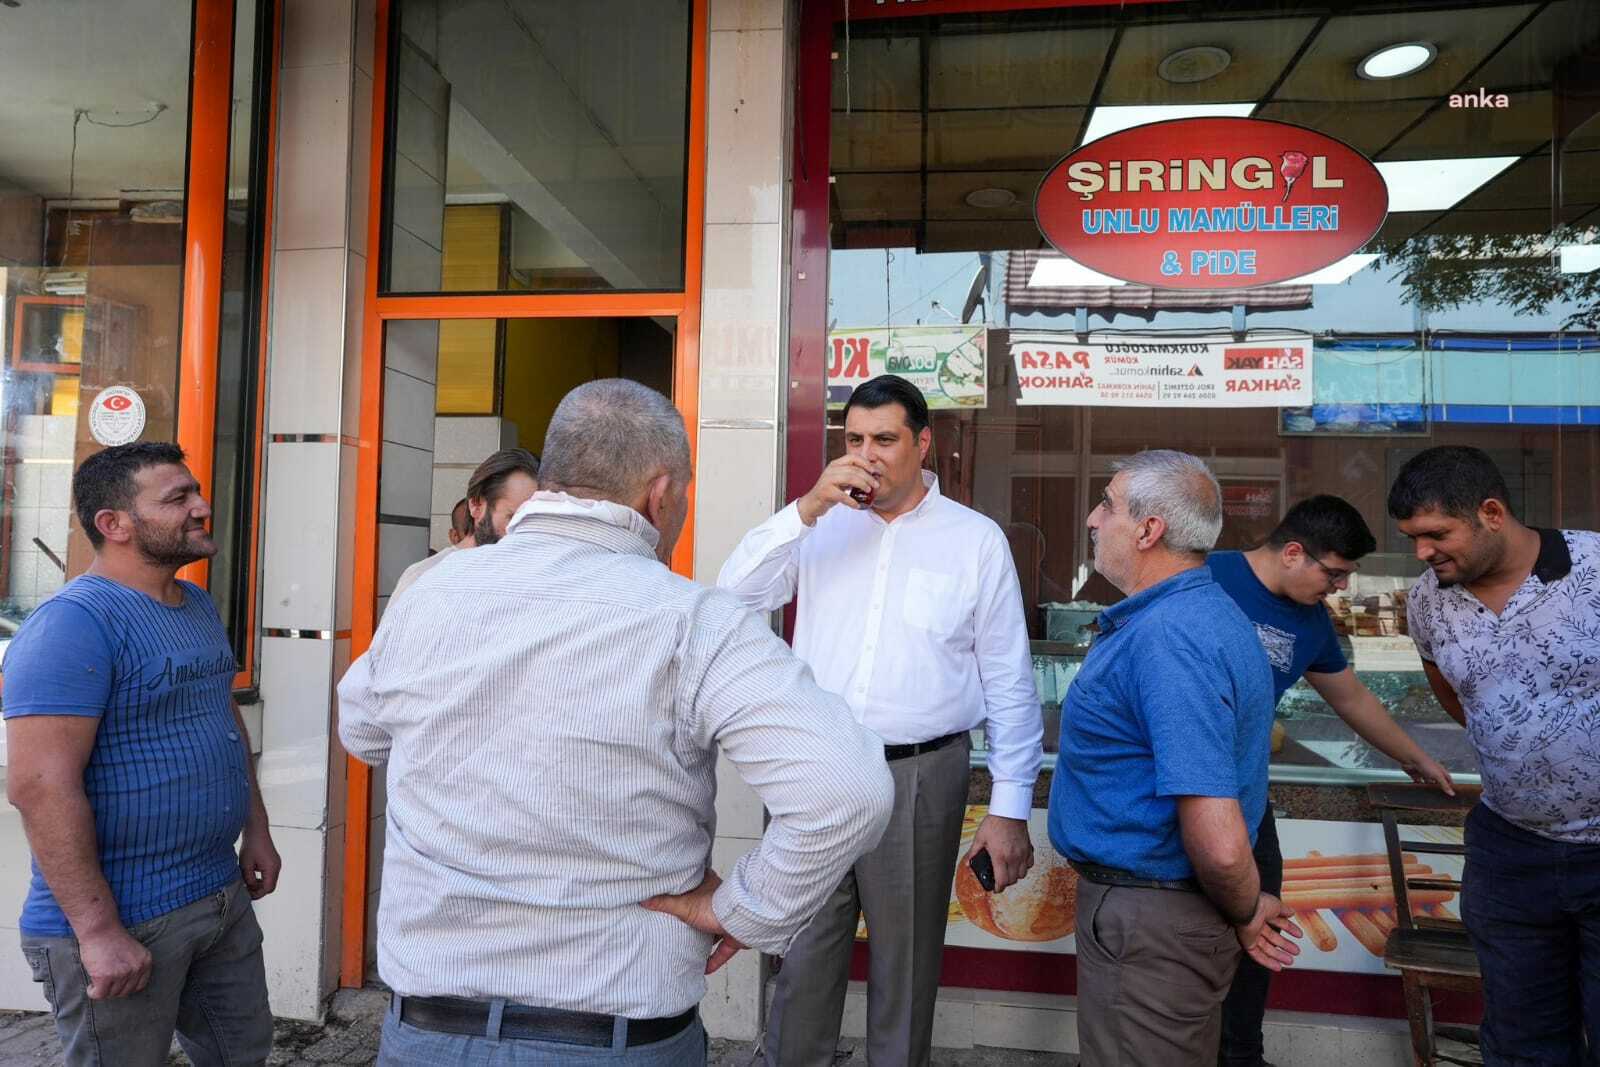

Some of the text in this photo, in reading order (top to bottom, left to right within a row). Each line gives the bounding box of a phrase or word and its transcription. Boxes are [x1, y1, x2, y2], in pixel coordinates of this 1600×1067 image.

[1082, 207, 1160, 234] UNLU
[1160, 250, 1182, 276] &
[144, 650, 238, 691] Amsterda
